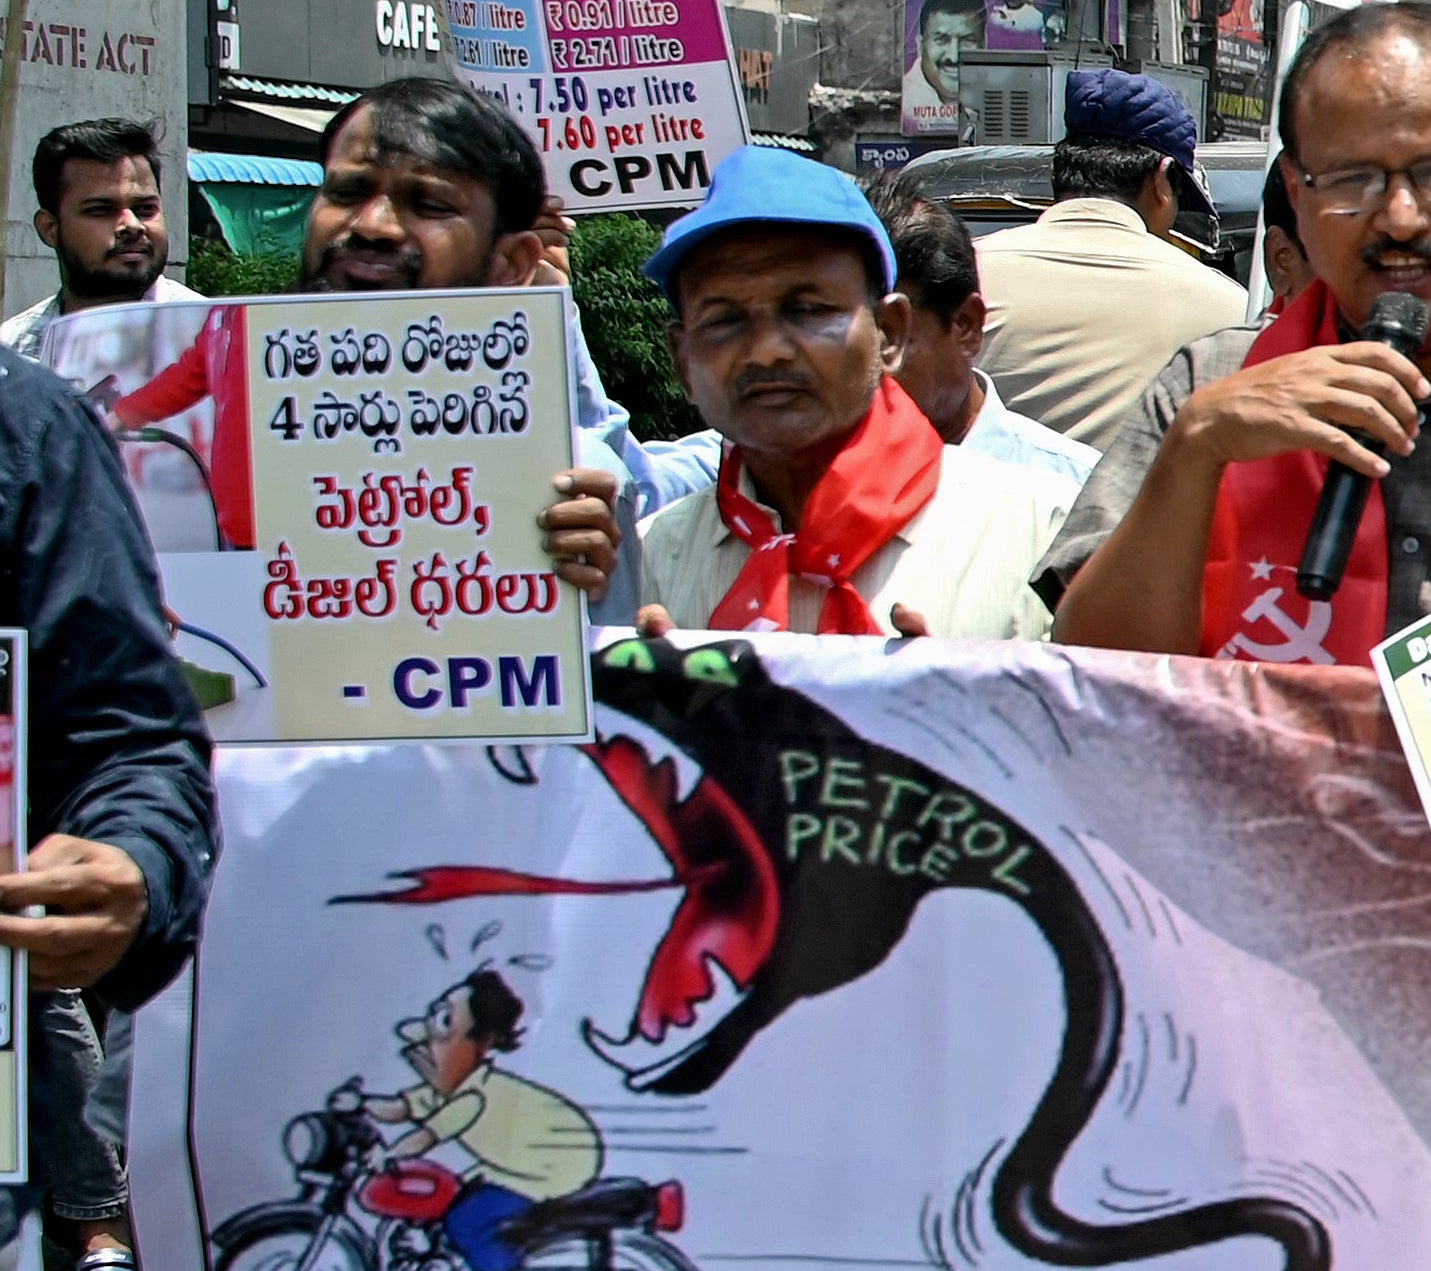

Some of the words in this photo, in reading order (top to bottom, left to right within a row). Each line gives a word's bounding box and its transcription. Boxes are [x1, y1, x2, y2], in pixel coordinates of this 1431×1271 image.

[567, 2, 611, 30] 0.91
[95, 30, 156, 76] ACT
[570, 39, 618, 66] 2.71
[530, 77, 589, 114] 7.50
[599, 84, 637, 116] per
[646, 76, 698, 105] litre
[537, 115, 597, 152] 7.60
[606, 121, 645, 153] per
[655, 112, 705, 144] litre
[569, 150, 711, 198] CPM
[264, 328, 322, 379] గత
[330, 326, 392, 378] పది
[402, 311, 532, 389] రోజుల్లో
[269, 396, 305, 442] 4
[313, 391, 404, 455] సార్లు
[408, 384, 530, 437] పెరిగిన
[312, 466, 492, 549] పెట్రోల్,
[262, 541, 398, 622] డీజిల్
[410, 552, 560, 632] ధరలు
[392, 654, 562, 710] CPM
[779, 749, 1033, 896] PETROL
[787, 812, 960, 881] PRICE
